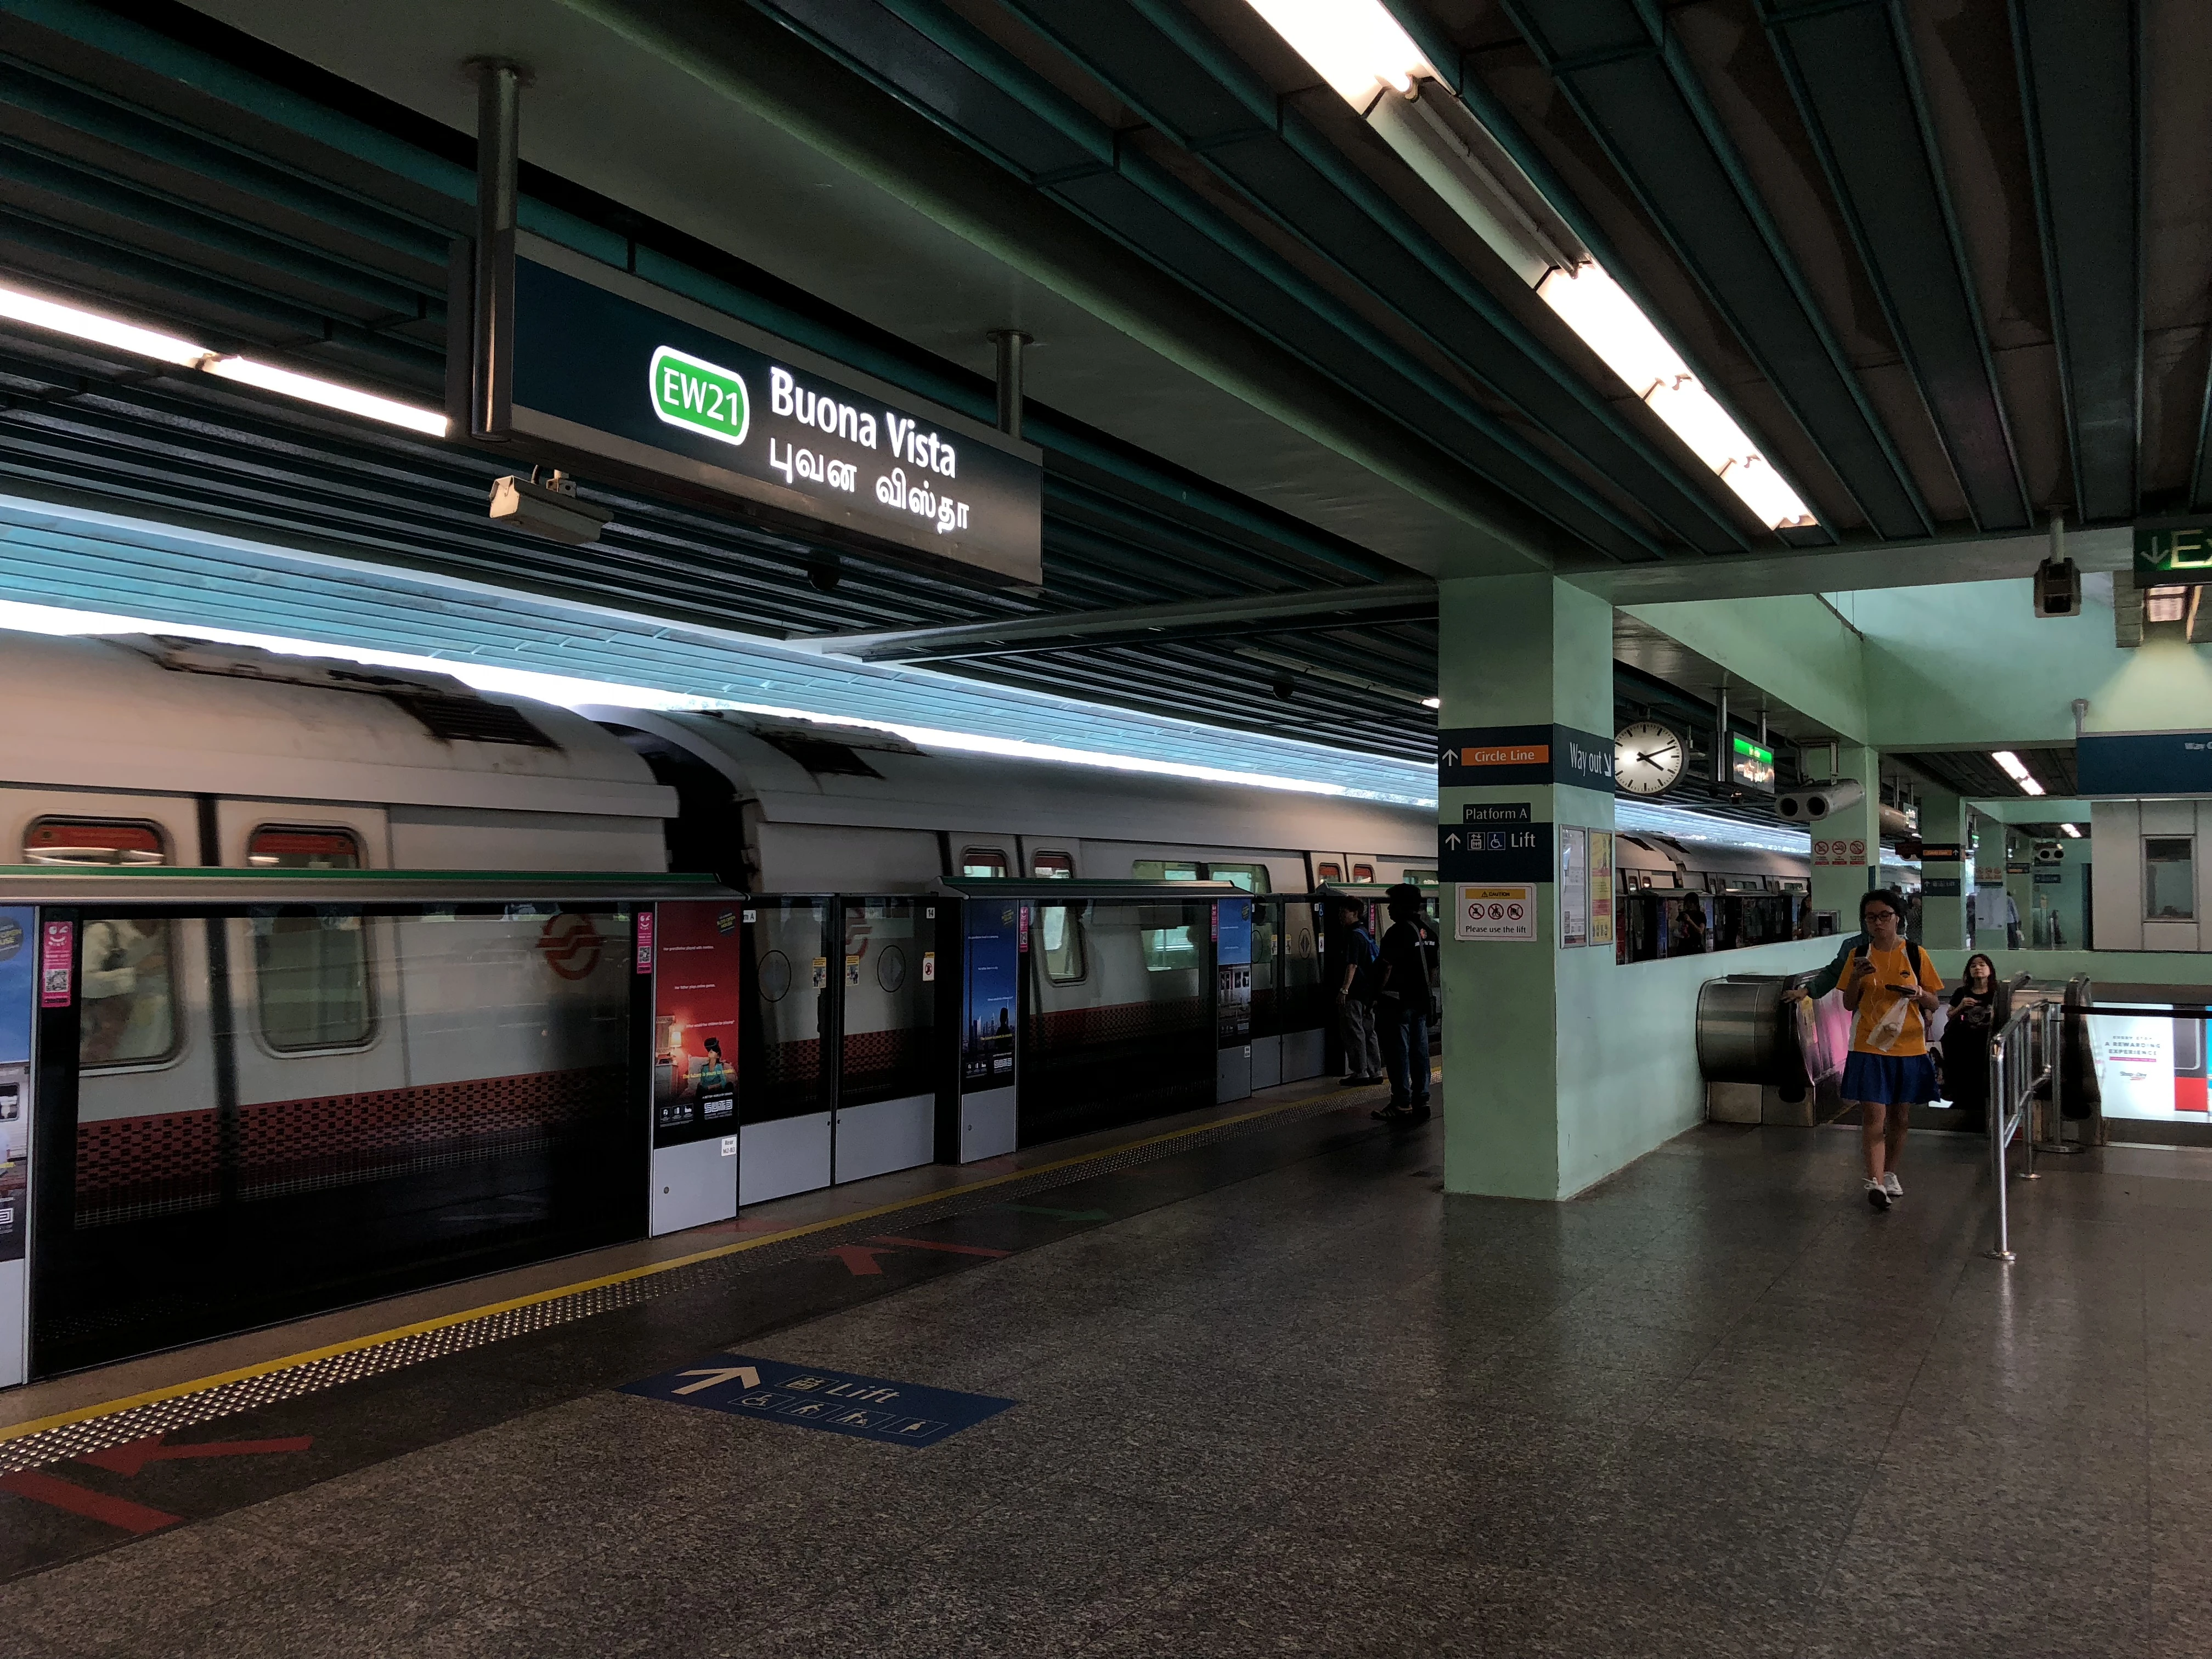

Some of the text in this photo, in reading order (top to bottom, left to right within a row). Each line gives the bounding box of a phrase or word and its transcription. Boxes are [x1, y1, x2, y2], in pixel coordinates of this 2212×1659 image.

[663, 366, 738, 427] EW21
[770, 366, 956, 479] Buona Vista
[769, 437, 970, 534] புவன விஸ்தா
[1475, 750, 1535, 762] Circle Line
[1570, 742, 1602, 777] Way out
[1466, 808, 1527, 820] Platform A
[1511, 832, 1536, 848] Lift
[824, 1383, 900, 1404] Lift
